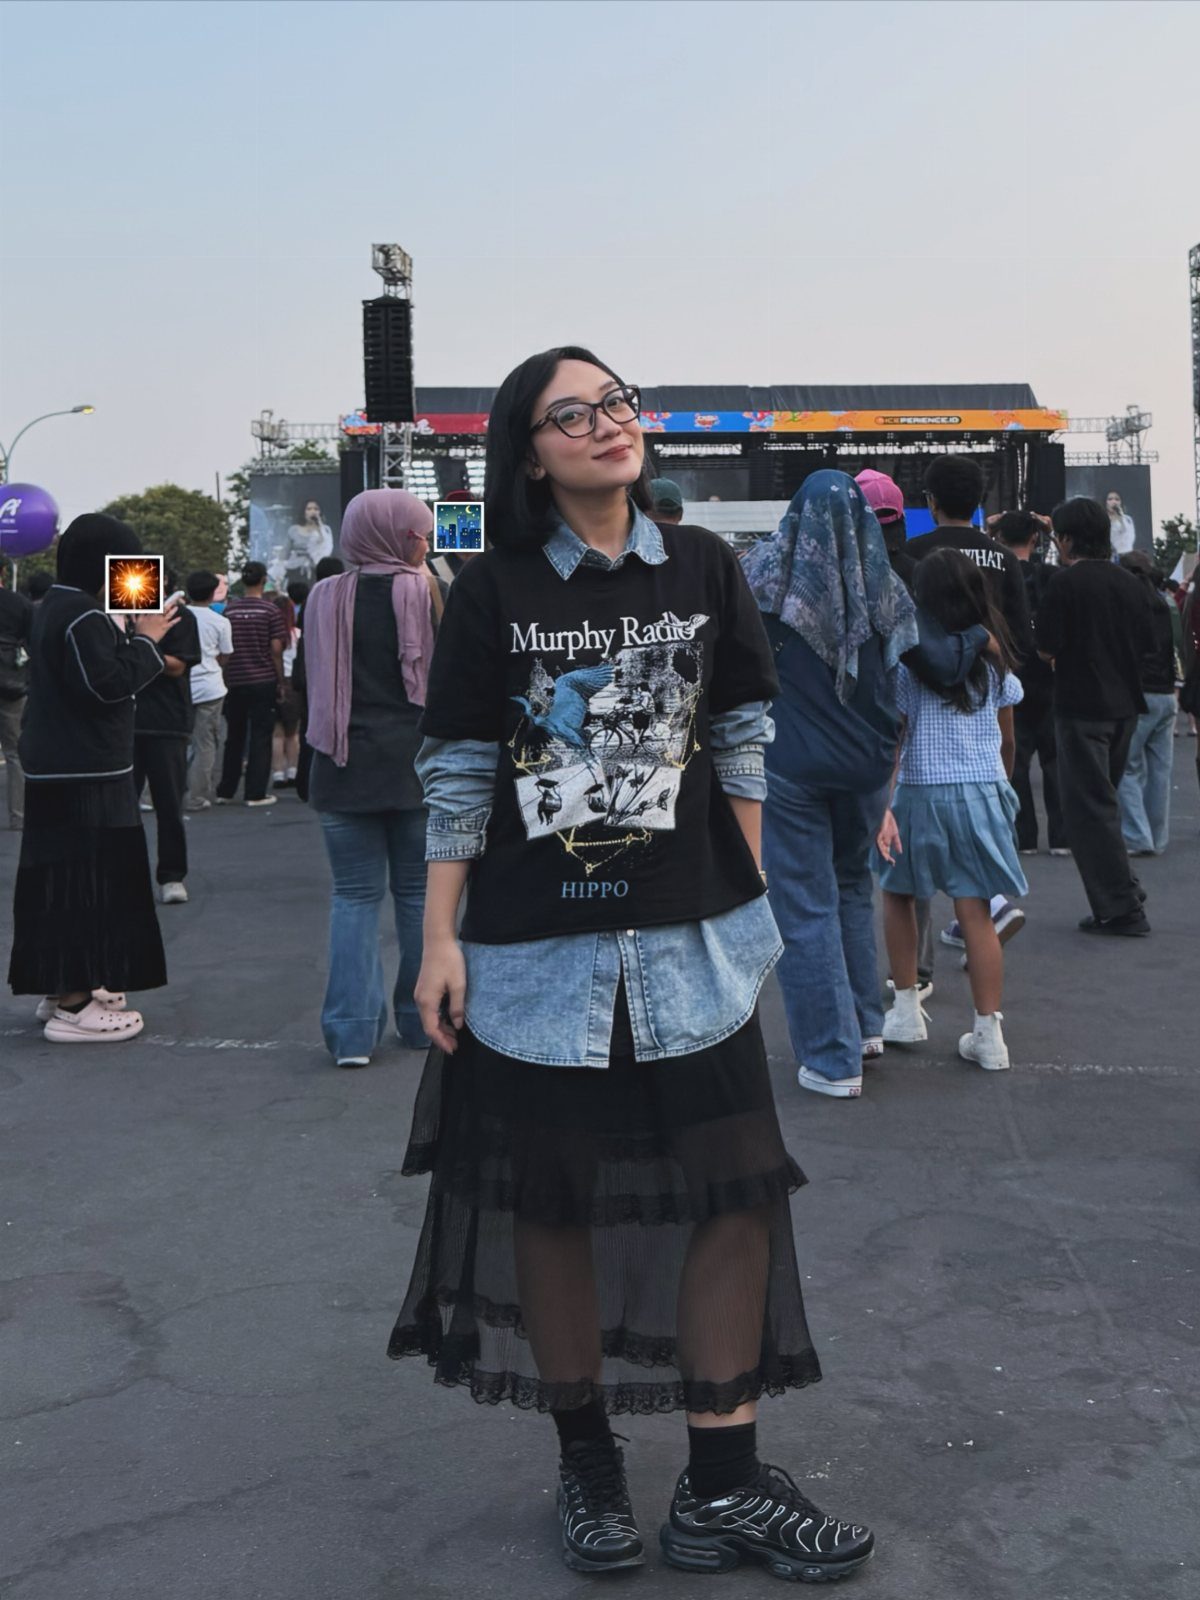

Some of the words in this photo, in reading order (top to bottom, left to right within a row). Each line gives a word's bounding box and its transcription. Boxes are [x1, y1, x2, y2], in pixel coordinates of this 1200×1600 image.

[509, 620, 617, 660] Murphy
[620, 611, 695, 647] Radio
[560, 879, 629, 899] HIPPO
